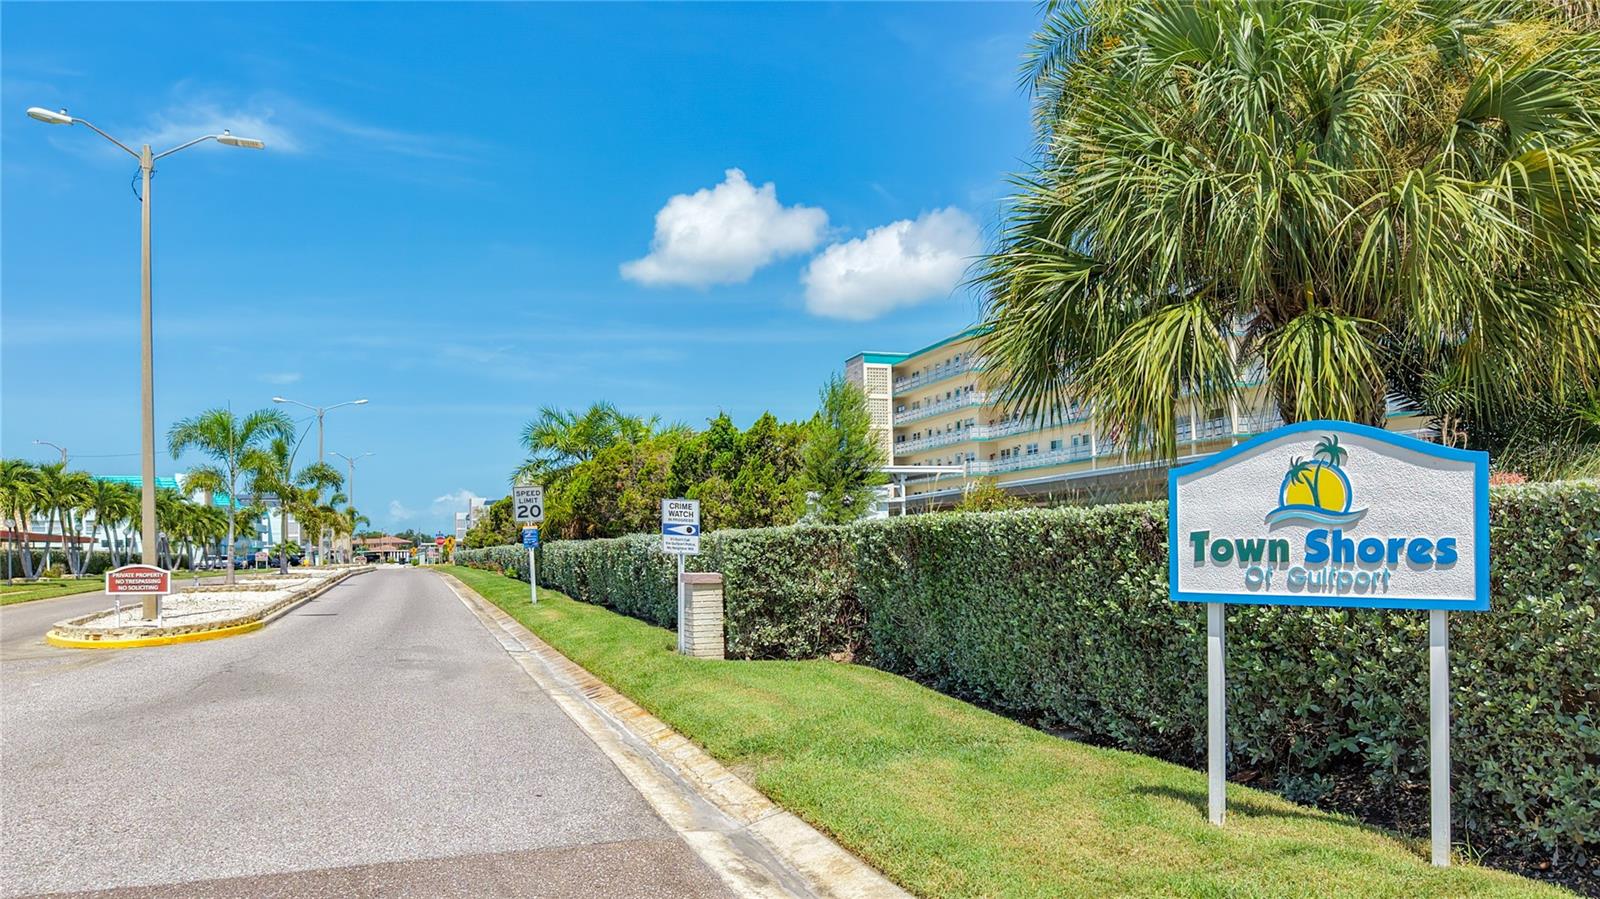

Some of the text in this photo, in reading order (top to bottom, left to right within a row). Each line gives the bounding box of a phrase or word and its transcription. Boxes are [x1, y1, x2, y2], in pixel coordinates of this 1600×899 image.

[517, 505, 542, 519] 20
[669, 502, 693, 510] CRIME
[668, 510, 694, 518] WATCH
[1189, 528, 1459, 565] Town Shores
[1245, 565, 1391, 592] Of Gulfport
